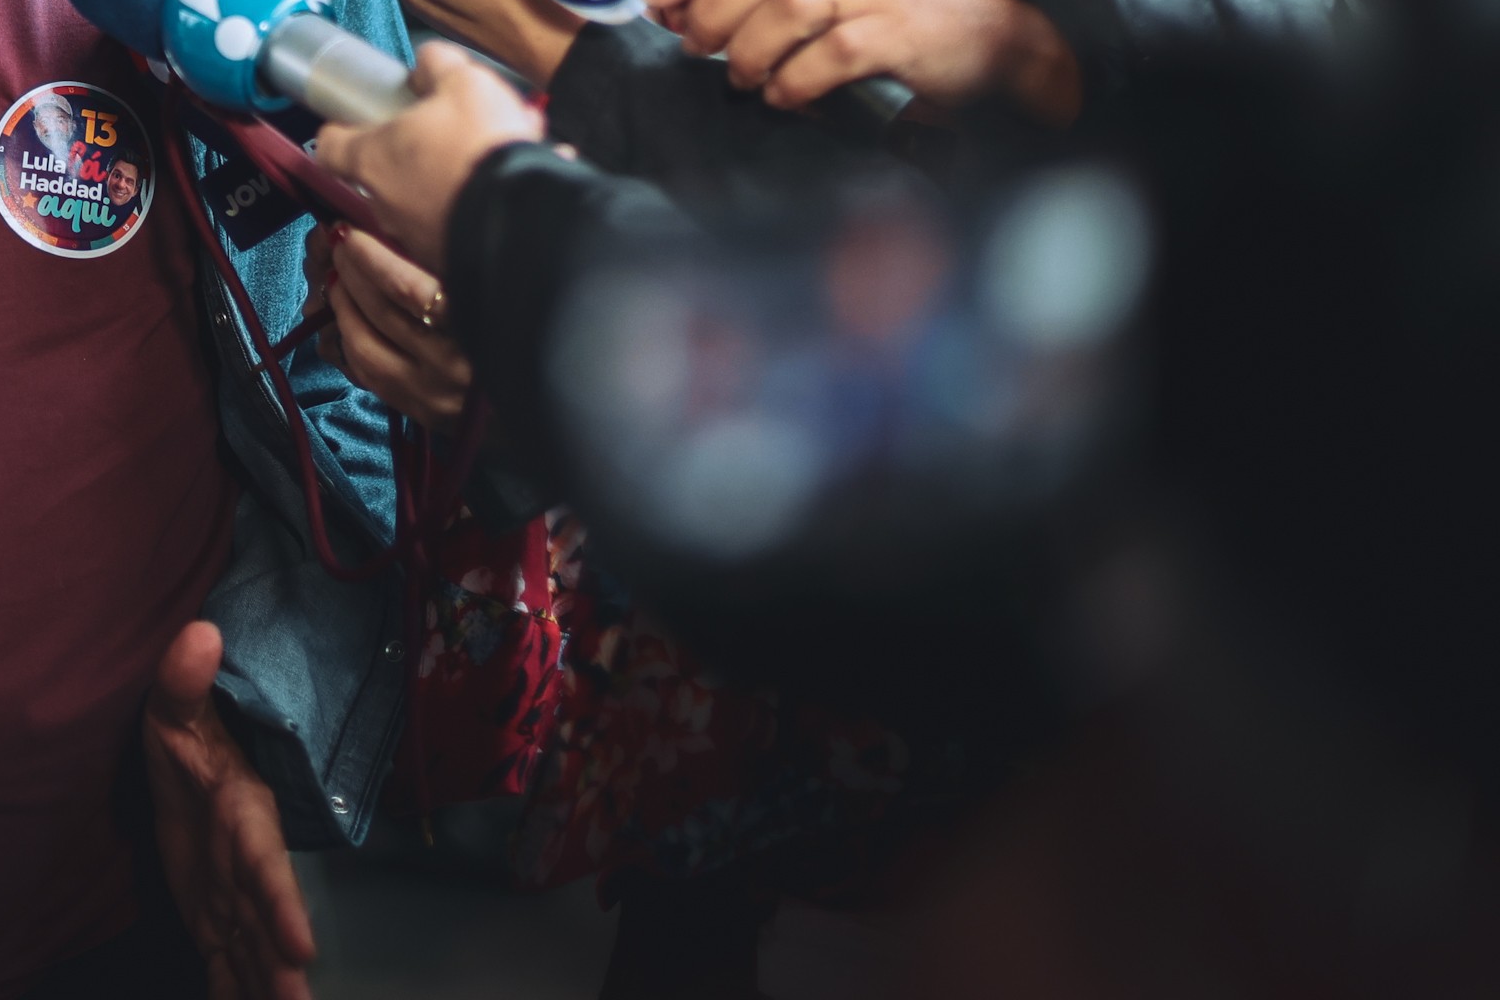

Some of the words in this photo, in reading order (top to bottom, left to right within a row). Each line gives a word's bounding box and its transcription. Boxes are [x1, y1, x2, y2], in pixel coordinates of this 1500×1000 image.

[80, 108, 119, 148] 13
[21, 151, 67, 175] Lula
[19, 171, 103, 202] Haddad
[225, 173, 271, 217] JOV
[37, 194, 117, 233] aqui
